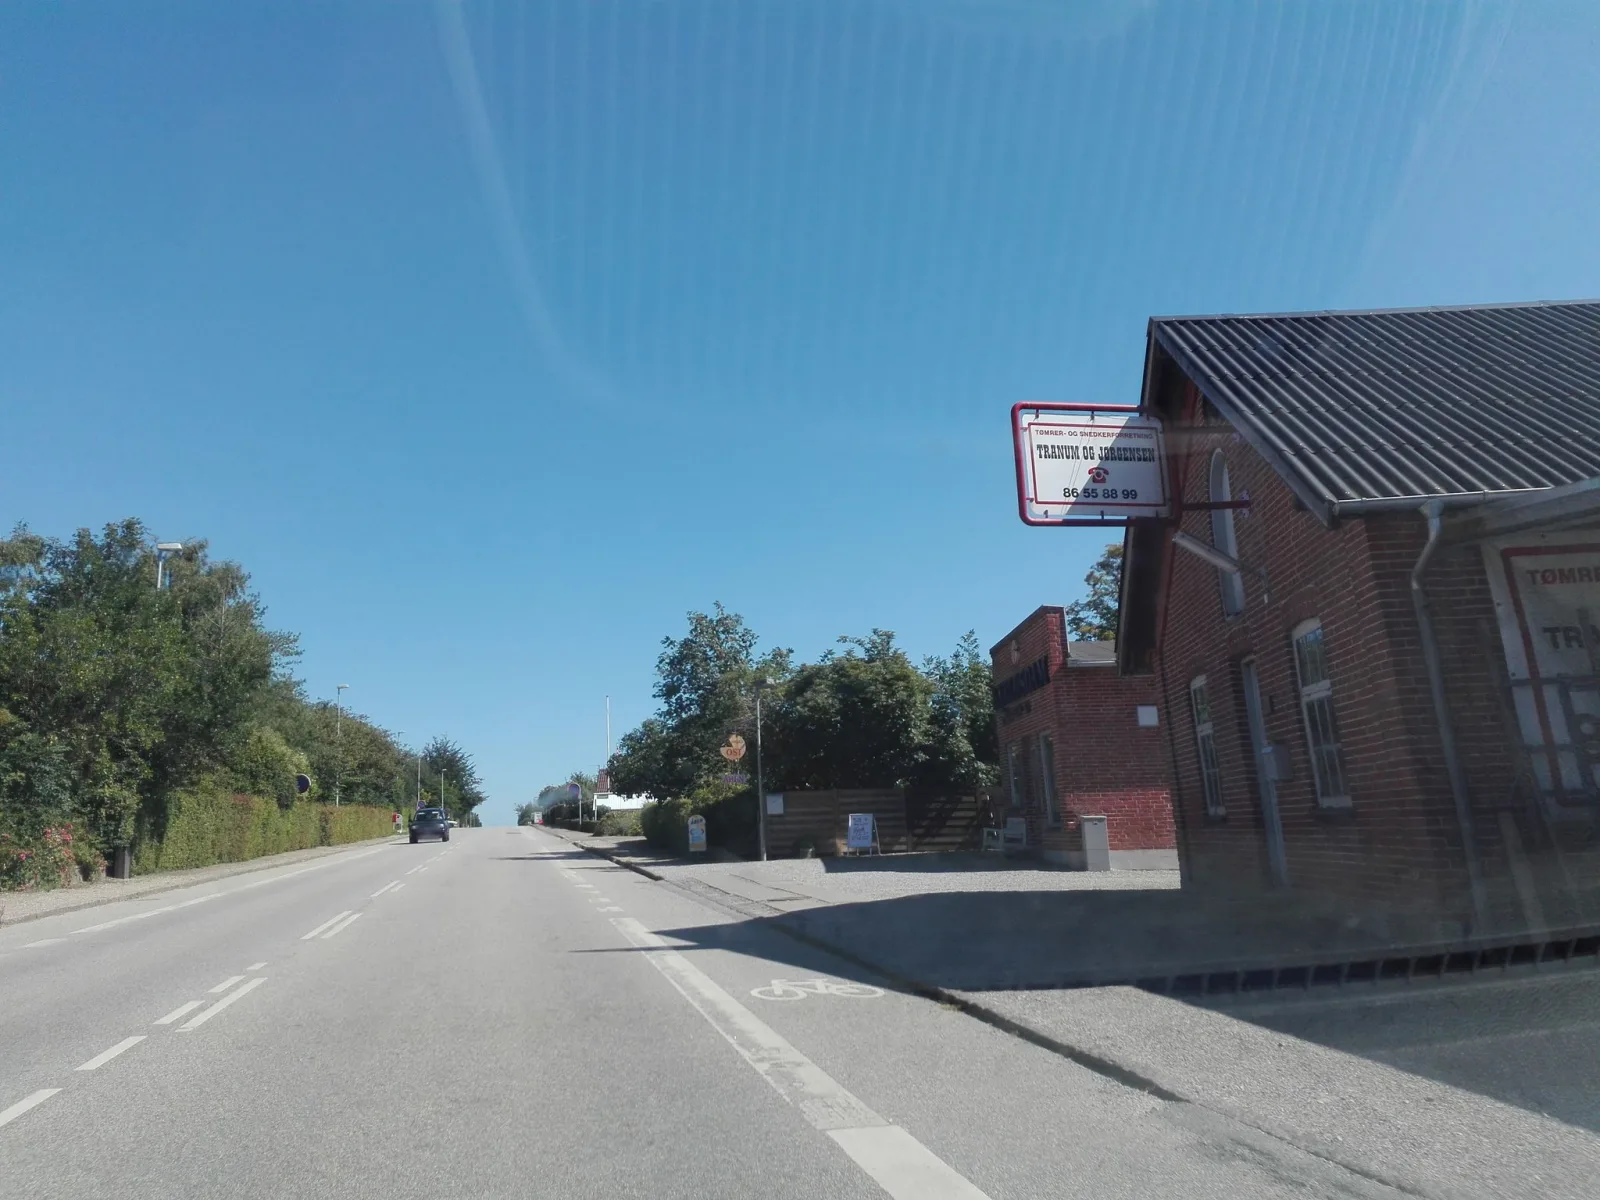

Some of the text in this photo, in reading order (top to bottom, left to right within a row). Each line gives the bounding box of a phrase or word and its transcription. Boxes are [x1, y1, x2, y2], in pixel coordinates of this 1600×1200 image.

[1035, 429, 1067, 437] TØMRER-
[1079, 431, 1154, 439] SNEDKERFORRETNING
[1036, 444, 1155, 462] TRANUM OG JØRGENSEN
[1063, 488, 1138, 500] 86 55 88 99
[1543, 625, 1600, 649] TR
